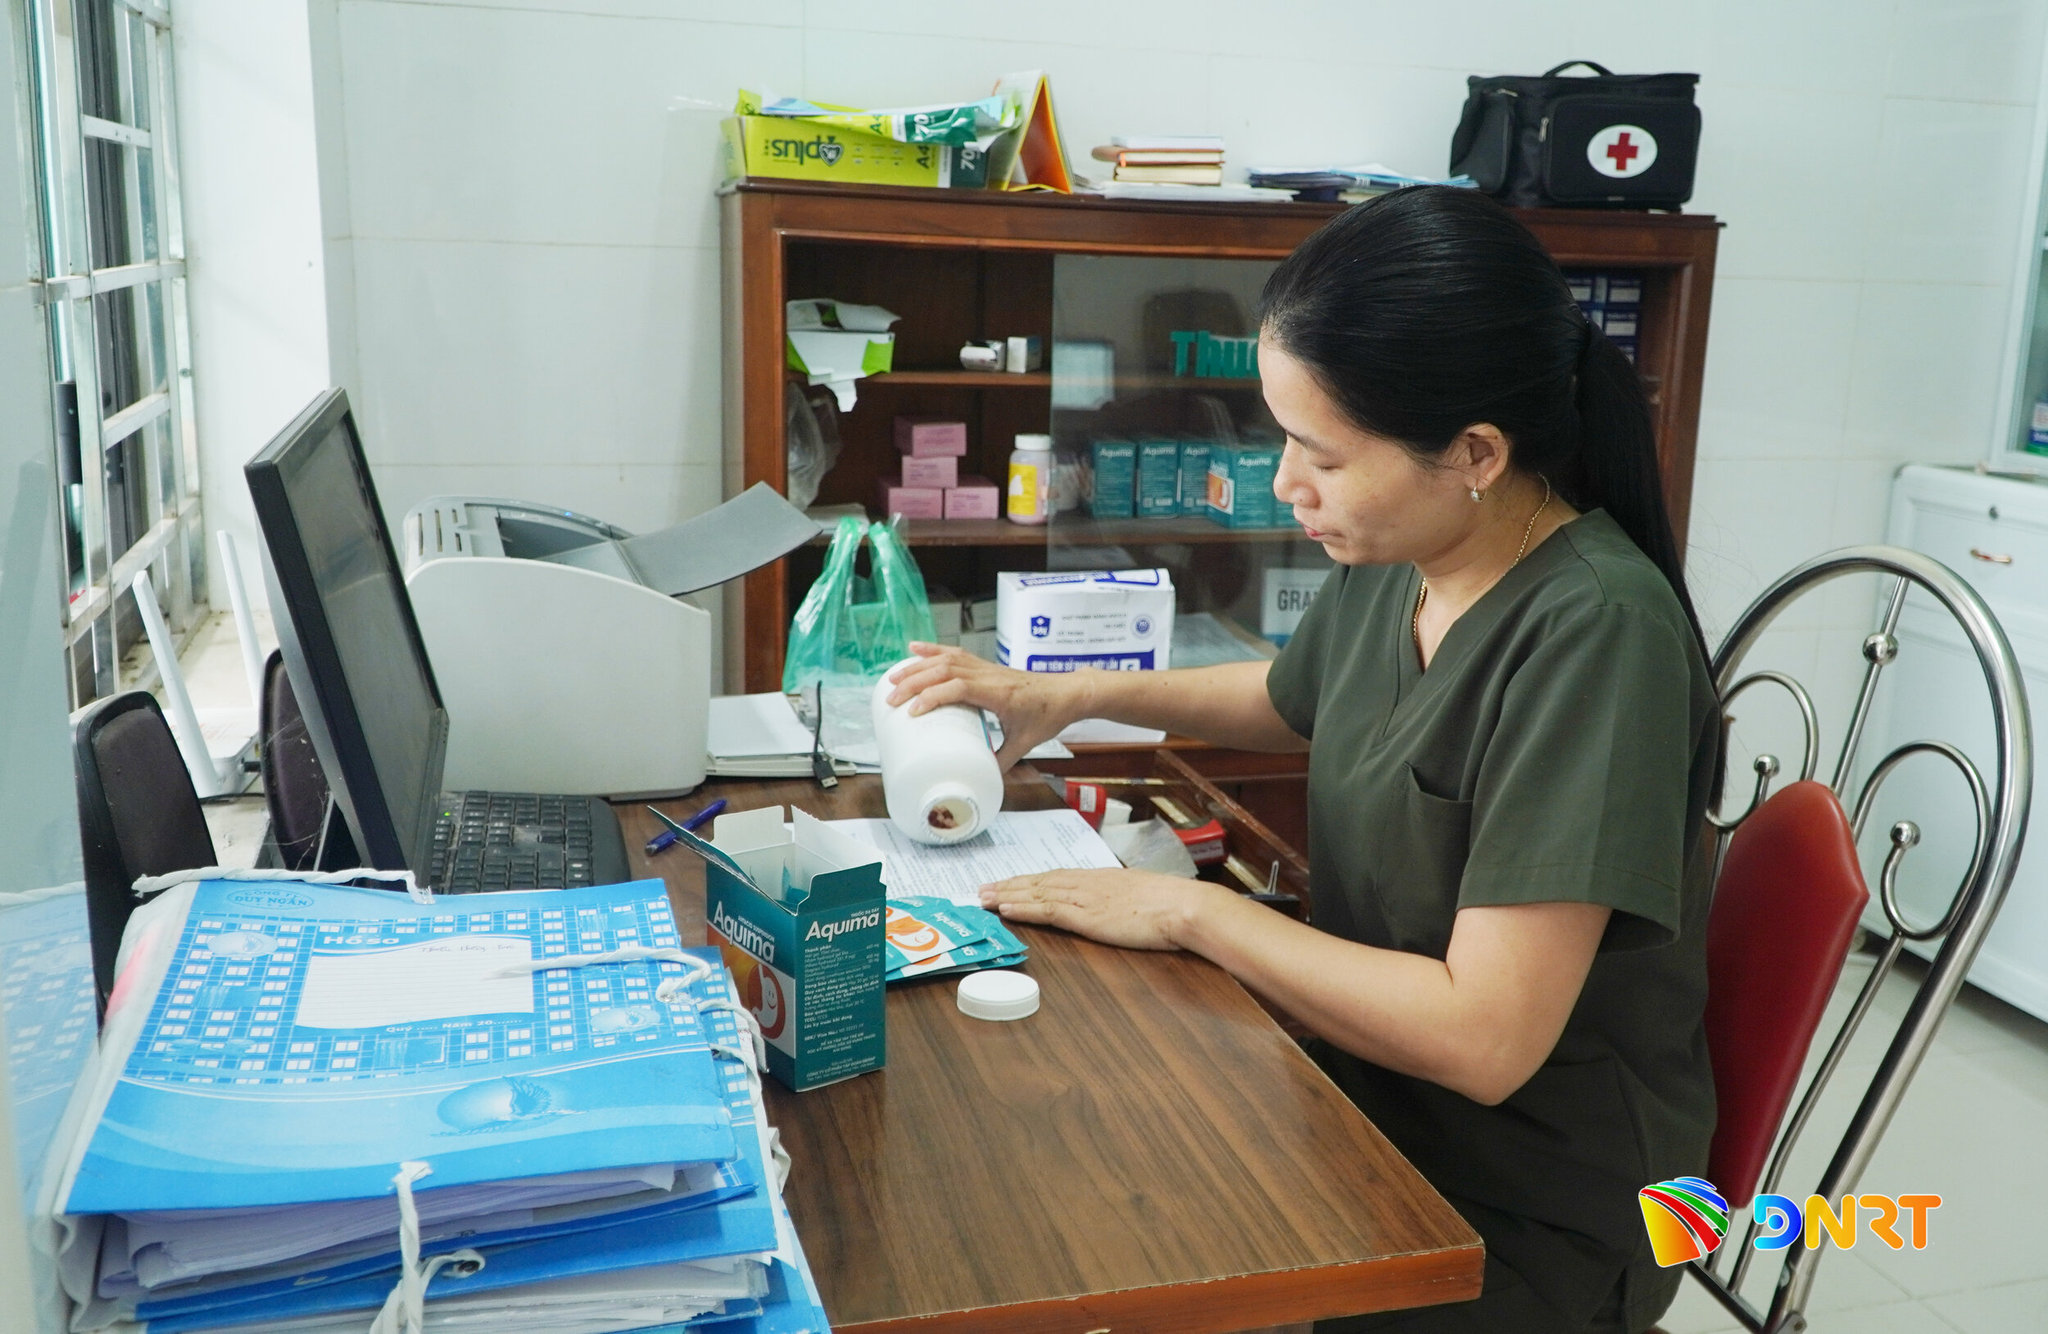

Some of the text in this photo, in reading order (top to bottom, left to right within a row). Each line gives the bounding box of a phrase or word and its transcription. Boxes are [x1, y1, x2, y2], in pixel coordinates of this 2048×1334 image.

[772, 135, 821, 166] plus
[234, 895, 264, 903] DUY
[714, 900, 775, 963] Aquima
[805, 913, 879, 942] Aquima
